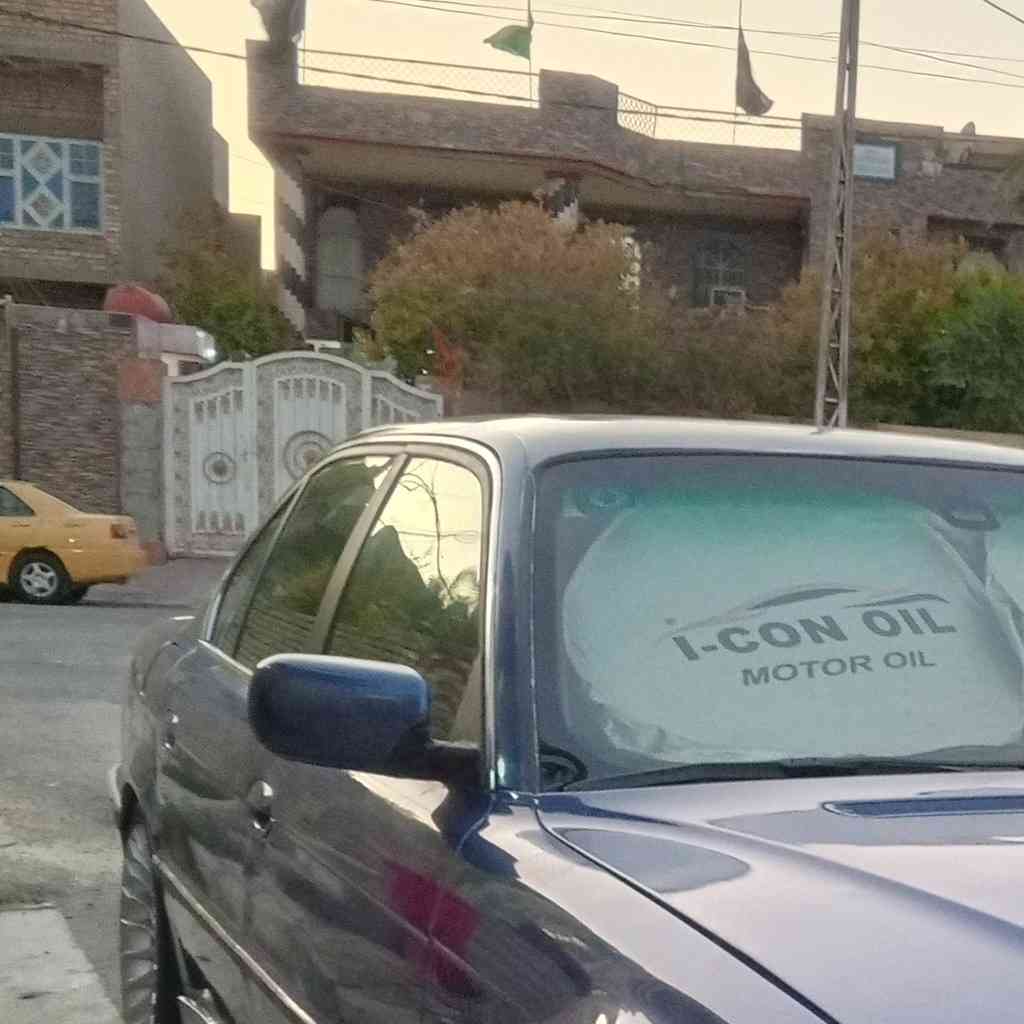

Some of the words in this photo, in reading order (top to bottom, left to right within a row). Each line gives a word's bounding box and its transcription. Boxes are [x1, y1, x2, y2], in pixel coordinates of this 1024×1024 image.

[861, 607, 957, 637] OIL
[741, 655, 873, 686] MOTOR
[883, 650, 936, 669] OIL
